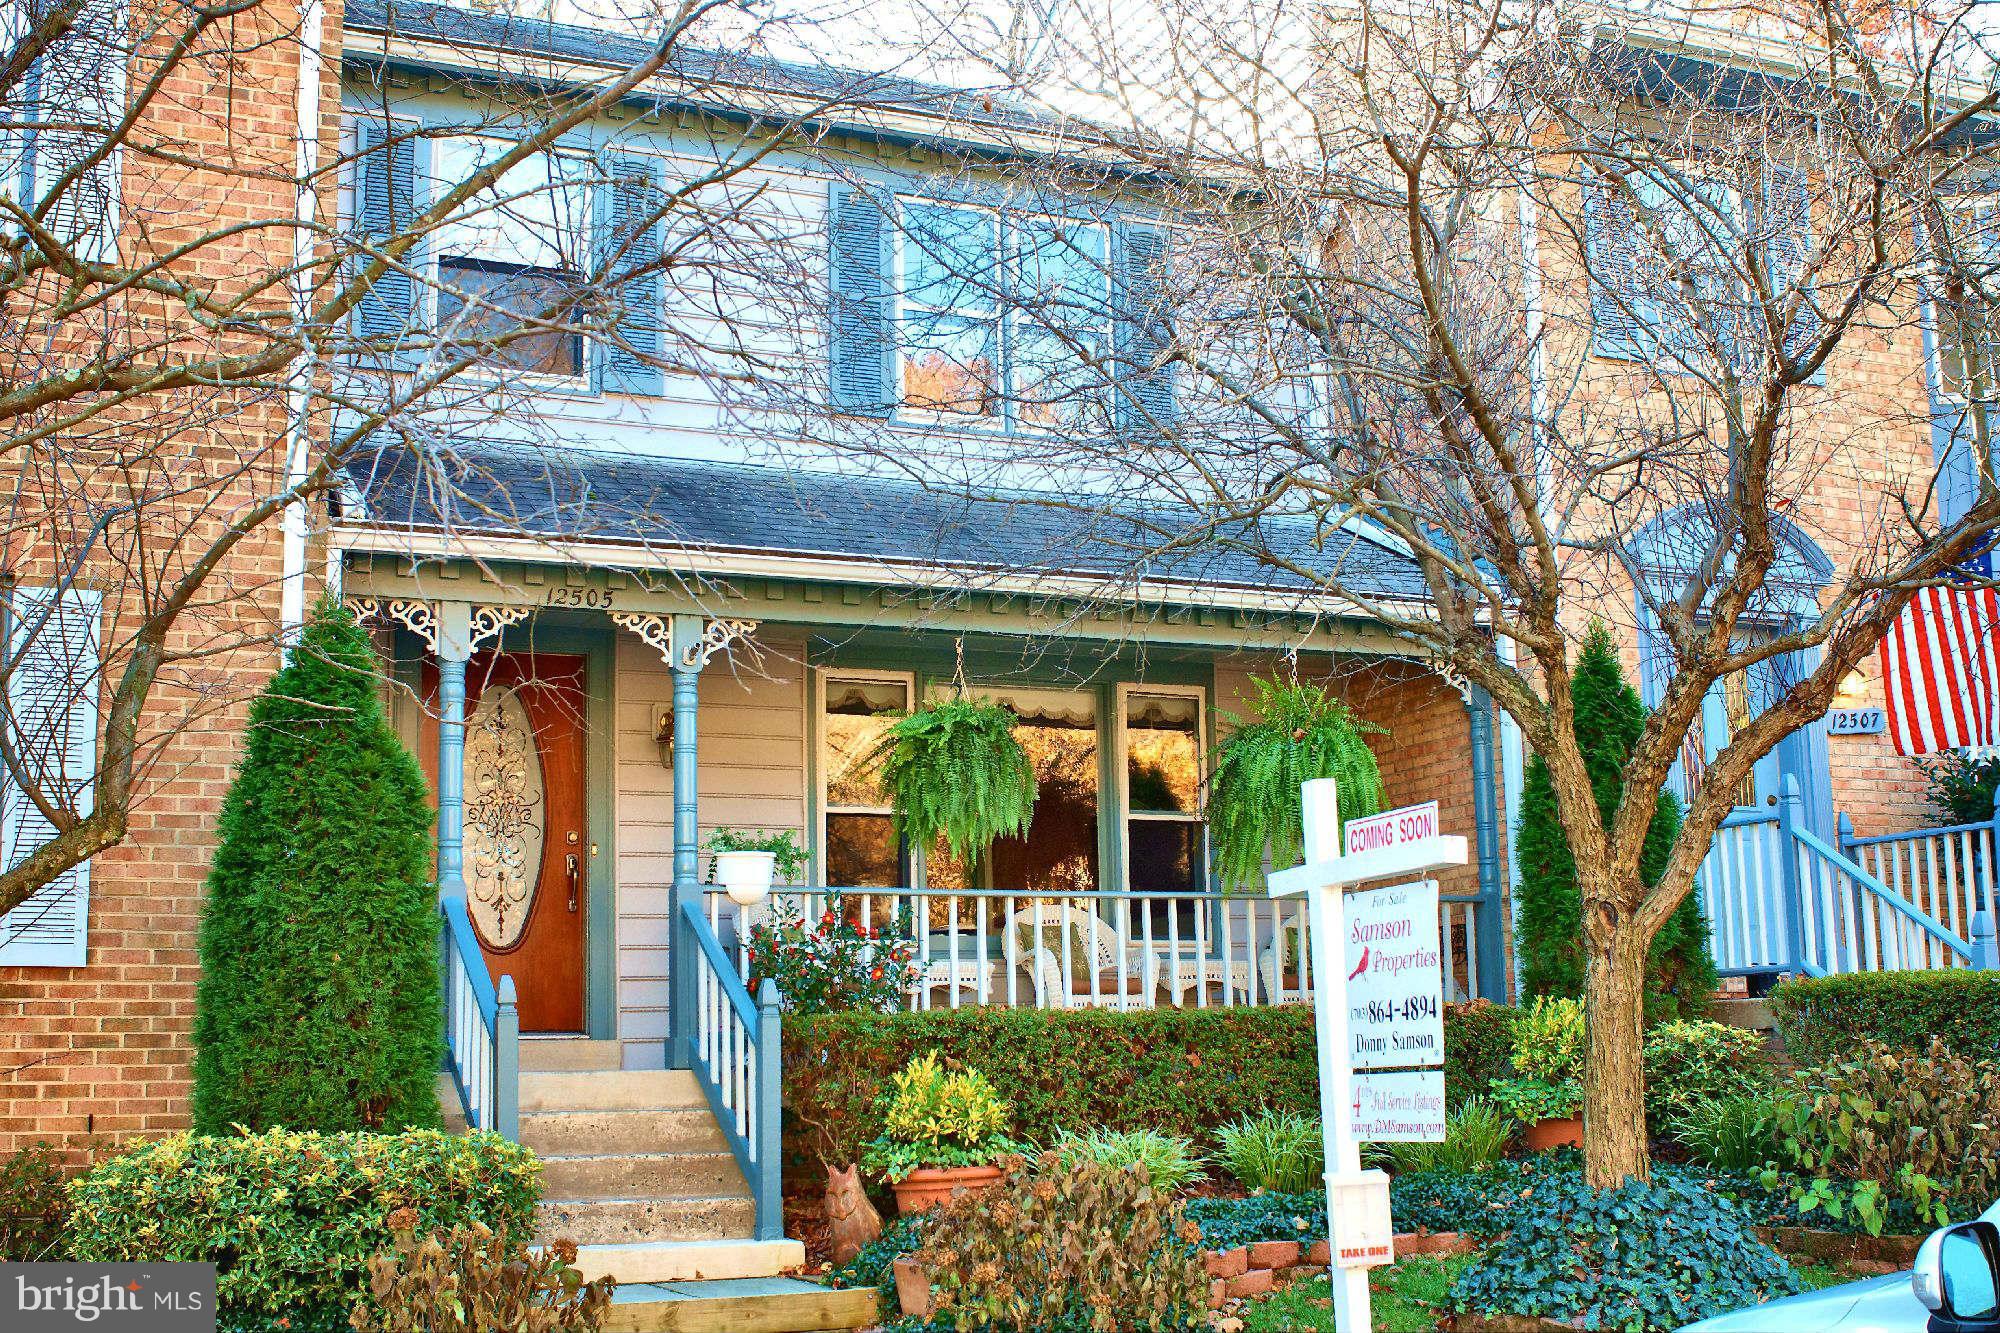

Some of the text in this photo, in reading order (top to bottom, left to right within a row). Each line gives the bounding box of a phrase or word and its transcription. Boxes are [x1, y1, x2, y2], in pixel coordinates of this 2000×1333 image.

[546, 587, 614, 608] 12505
[1832, 712, 1880, 730] 12507
[1350, 813, 1433, 853] COMING SOON
[1371, 895, 1386, 908] For
[1352, 918, 1412, 944] Samson
[1373, 947, 1437, 976] Properties
[1356, 1031, 1434, 1056] Donny Samson
[1340, 1246, 1389, 1258] TAKE ONE
